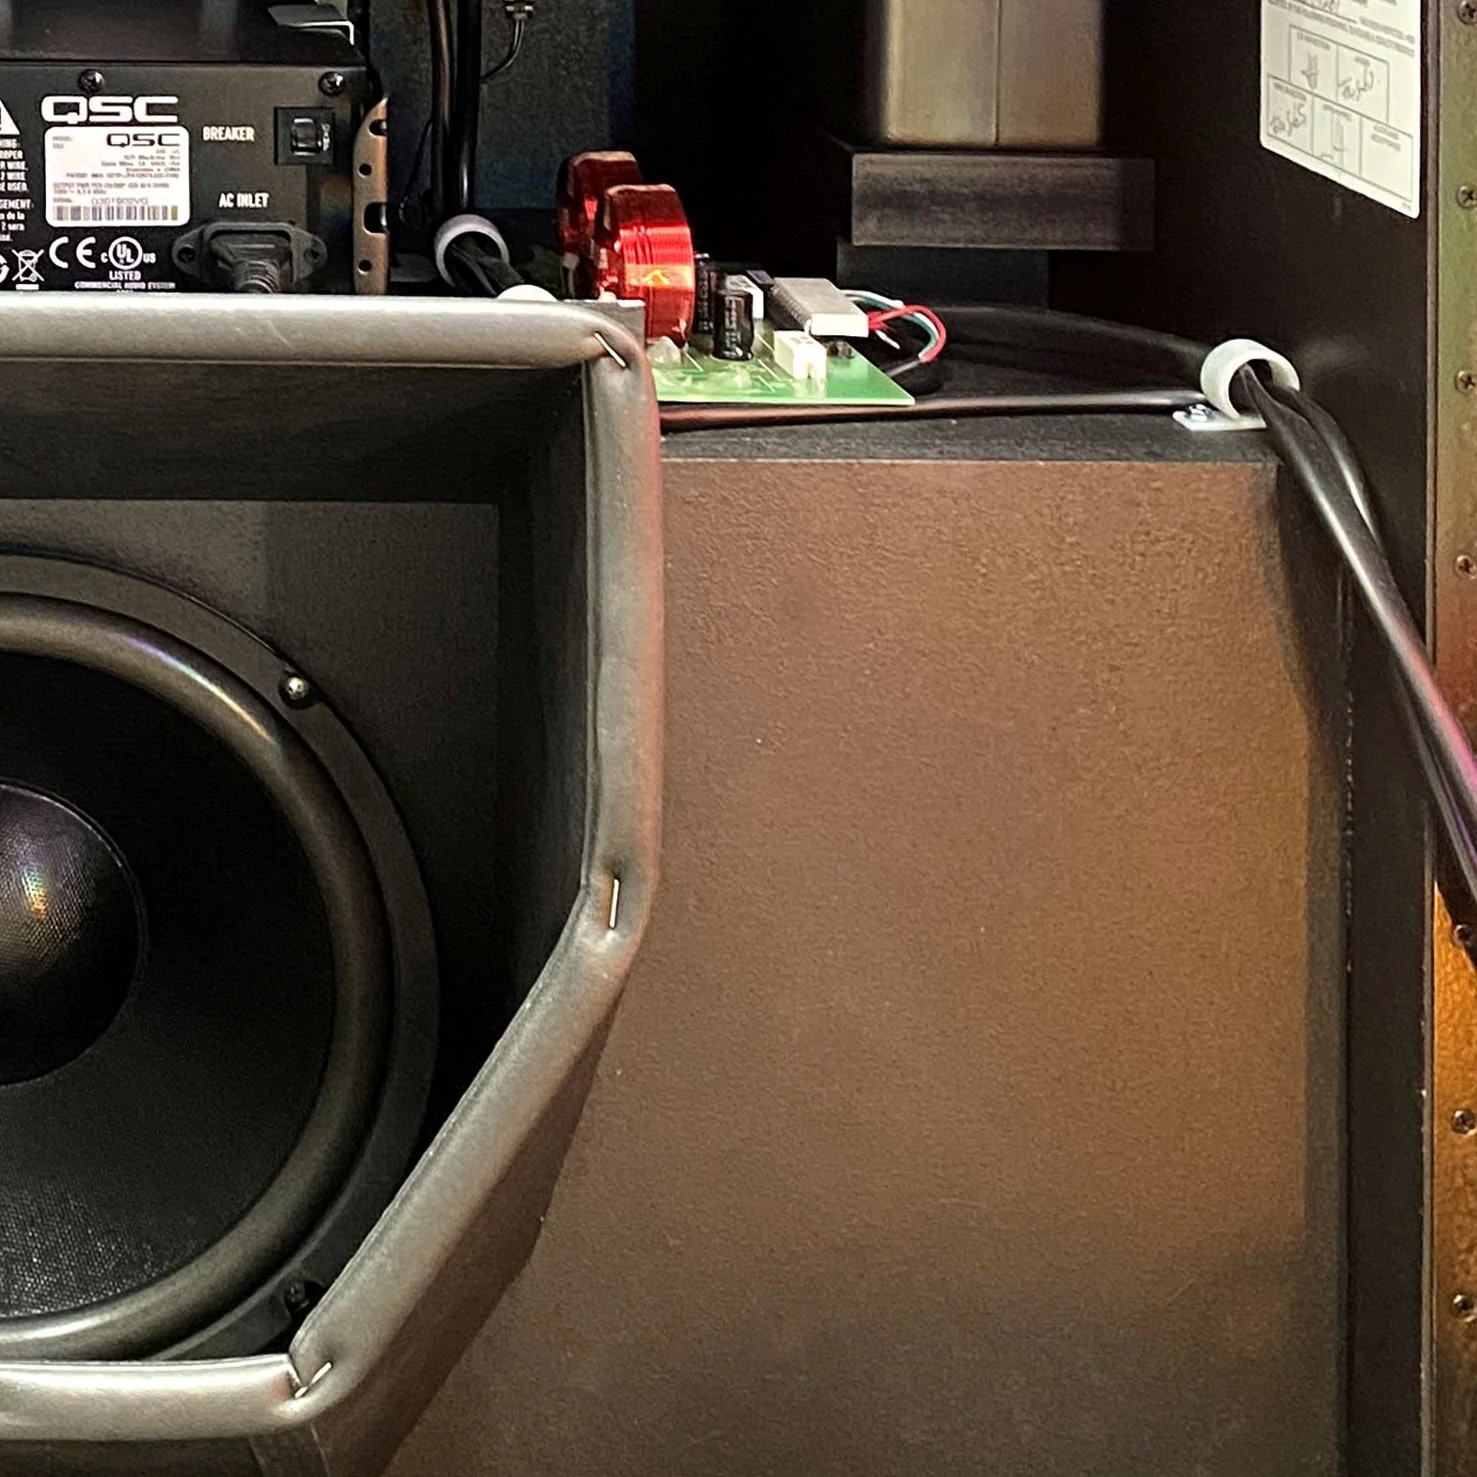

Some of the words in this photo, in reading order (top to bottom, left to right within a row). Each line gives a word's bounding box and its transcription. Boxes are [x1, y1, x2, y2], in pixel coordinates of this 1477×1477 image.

[40, 95, 179, 124] QSC
[106, 132, 181, 148] QSC
[203, 126, 255, 142] BREAKER
[7, 171, 25, 181] WIRE
[218, 192, 235, 208] AC
[236, 192, 270, 208] INLET
[48, 236, 97, 269] CE
[108, 270, 141, 281] LISTED
